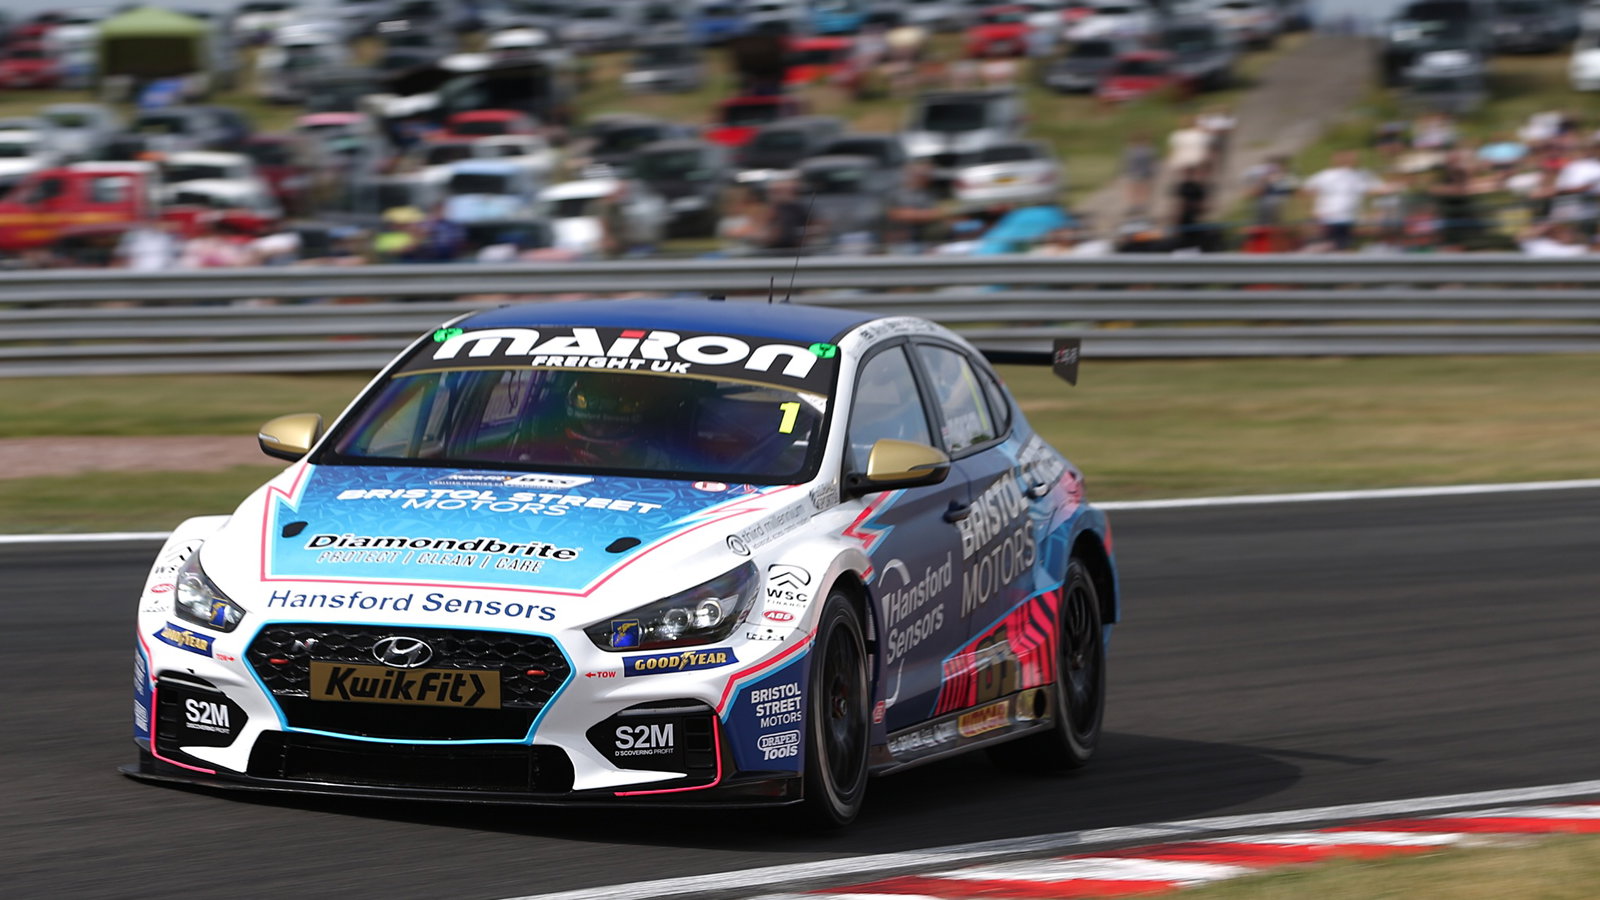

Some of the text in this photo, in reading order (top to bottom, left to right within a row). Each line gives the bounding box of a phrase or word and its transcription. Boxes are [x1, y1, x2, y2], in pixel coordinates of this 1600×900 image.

[532, 355, 692, 374] FREIGHT UK
[778, 402, 801, 433] 1
[337, 488, 662, 514] BRISTOL STREET
[402, 499, 571, 516] MOTORS
[956, 467, 1028, 561] BRISTOL
[306, 534, 579, 561] Diamondbrite
[317, 551, 545, 574] PROTECT CLEAN CARE
[961, 522, 1036, 619] MOTORS
[767, 588, 808, 602] WSC
[888, 552, 953, 627] Hansford
[267, 589, 557, 622] Hansford Sensors
[887, 603, 945, 665] Sensors
[634, 651, 727, 671] GOODYEAR
[597, 671, 617, 679] TOW
[751, 682, 802, 704] BRISTOL
[185, 698, 230, 728] S2M
[755, 697, 802, 717] STREET
[760, 711, 802, 729] MOTORS
[615, 723, 674, 749] S2M
[761, 733, 798, 748] DRAPER
[615, 747, 674, 757] DSCOVERING PROFIT
[763, 744, 798, 761] Tools
